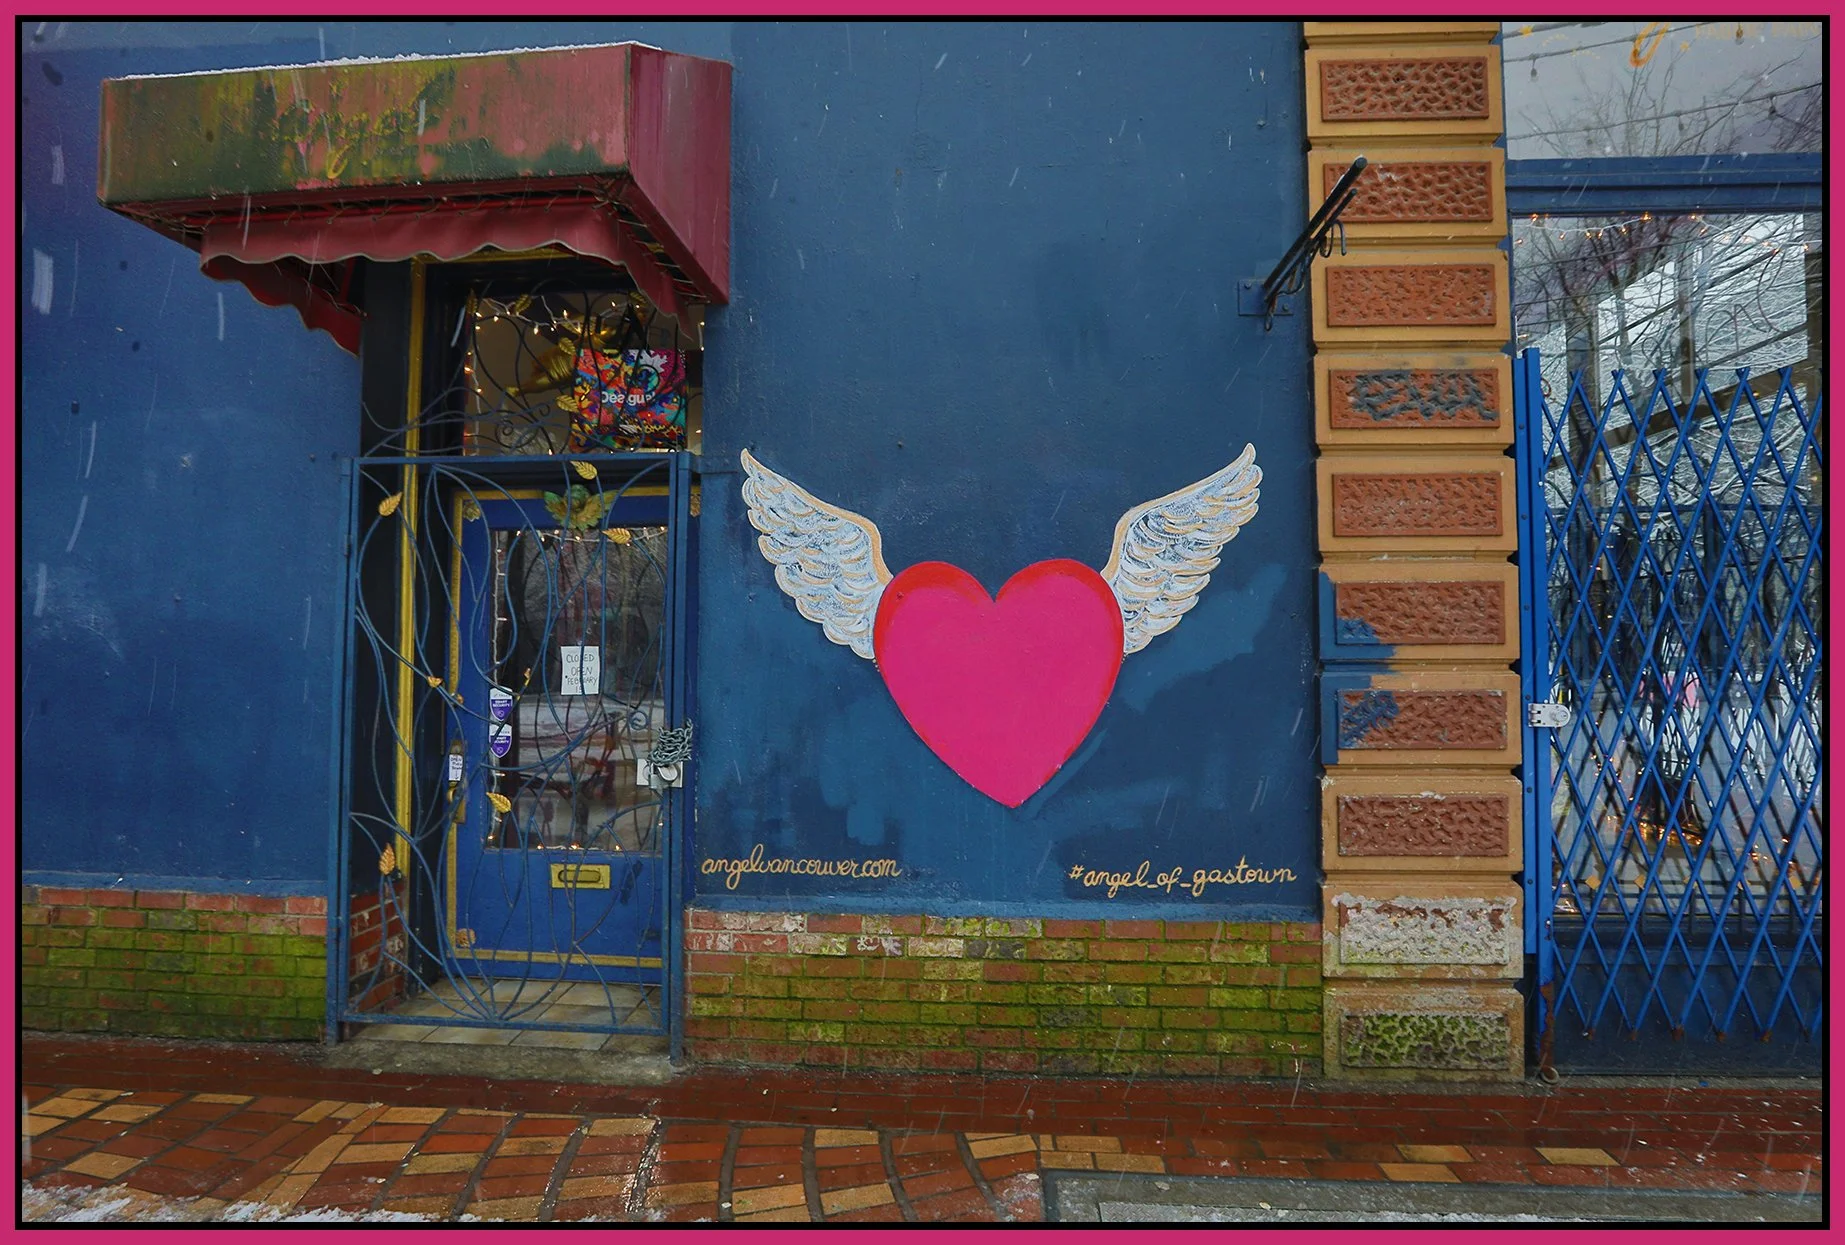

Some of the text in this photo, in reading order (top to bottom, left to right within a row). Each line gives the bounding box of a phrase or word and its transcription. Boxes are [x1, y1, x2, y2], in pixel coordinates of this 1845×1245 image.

[566, 653, 595, 663] CLOED
[701, 843, 902, 890] angelvancouver.com
[1068, 855, 1297, 898] #angel_of_gastown
